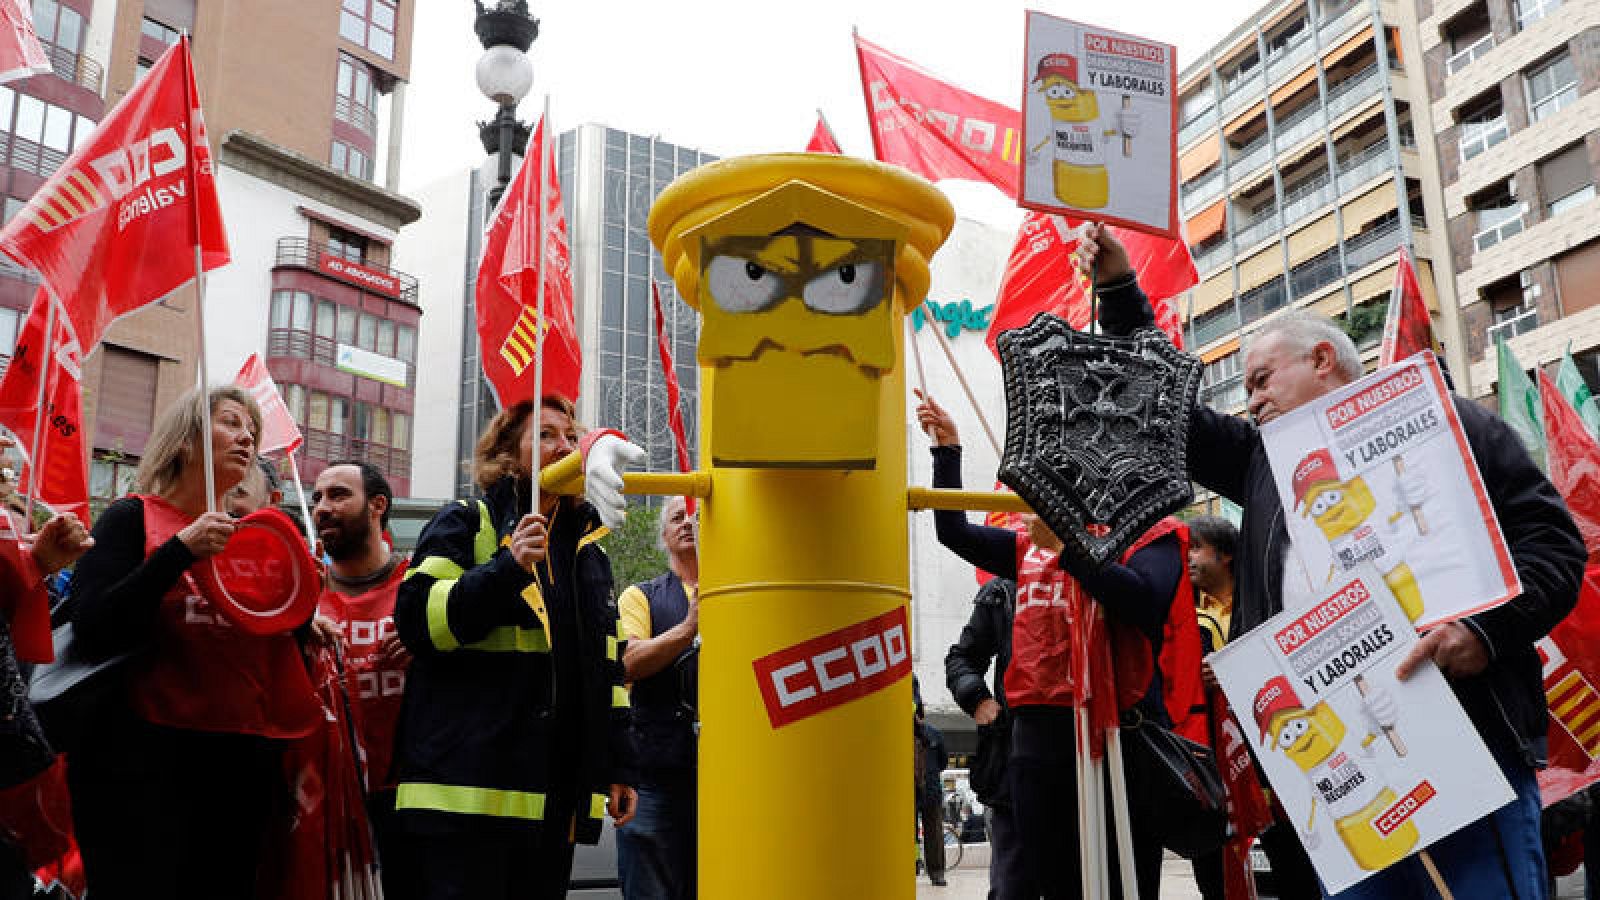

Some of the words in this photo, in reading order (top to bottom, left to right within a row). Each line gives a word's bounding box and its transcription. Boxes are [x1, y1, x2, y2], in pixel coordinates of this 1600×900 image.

[1329, 402, 1353, 427] POR
[1345, 449, 1358, 468] Y
[1360, 412, 1438, 463] LABORALES
[1278, 629, 1308, 651] POR
[1306, 584, 1369, 632] NUESTROS
[770, 623, 907, 708] CCOO
[1304, 676, 1318, 694] Y
[1318, 623, 1395, 686] LABORALES
[1380, 796, 1418, 832] CCOO
